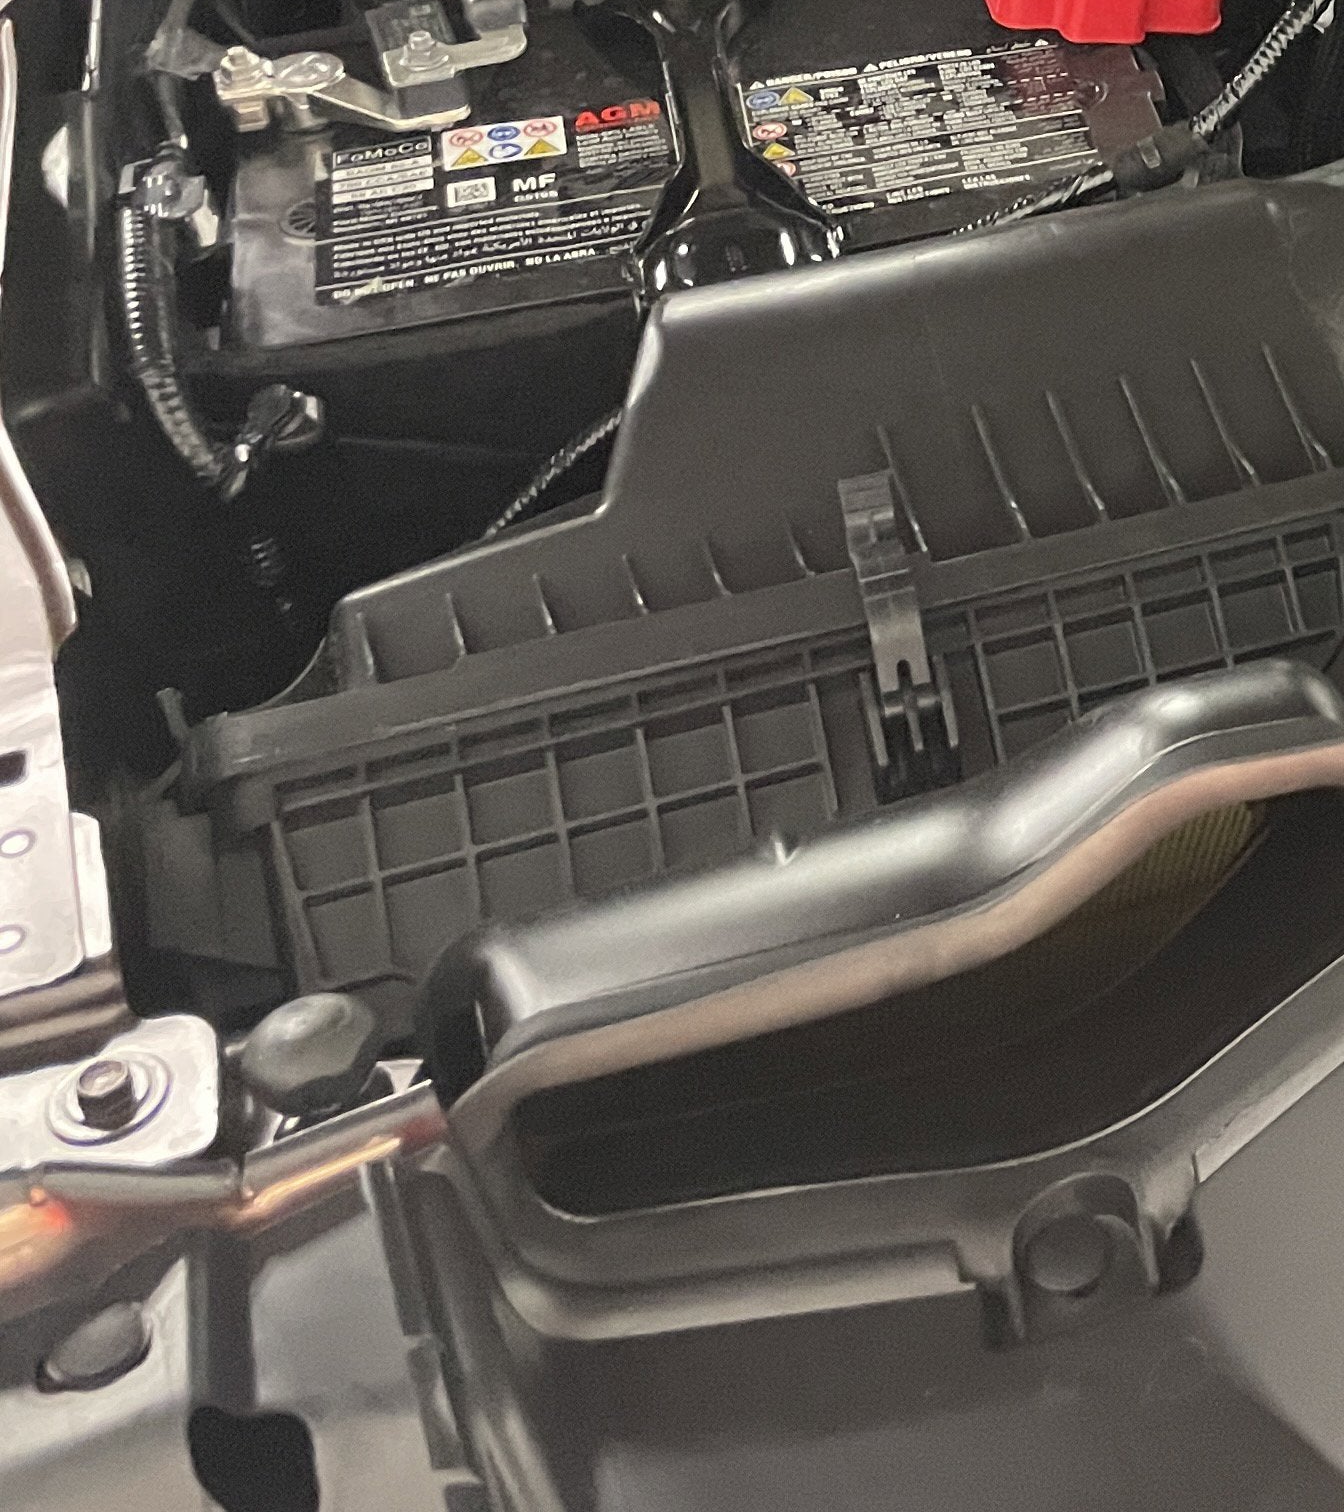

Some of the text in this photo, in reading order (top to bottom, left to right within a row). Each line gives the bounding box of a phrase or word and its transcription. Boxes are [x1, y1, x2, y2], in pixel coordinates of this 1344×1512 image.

[575, 100, 660, 127] AGM
[337, 142, 428, 164] FoMoCo
[513, 172, 556, 192] MF
